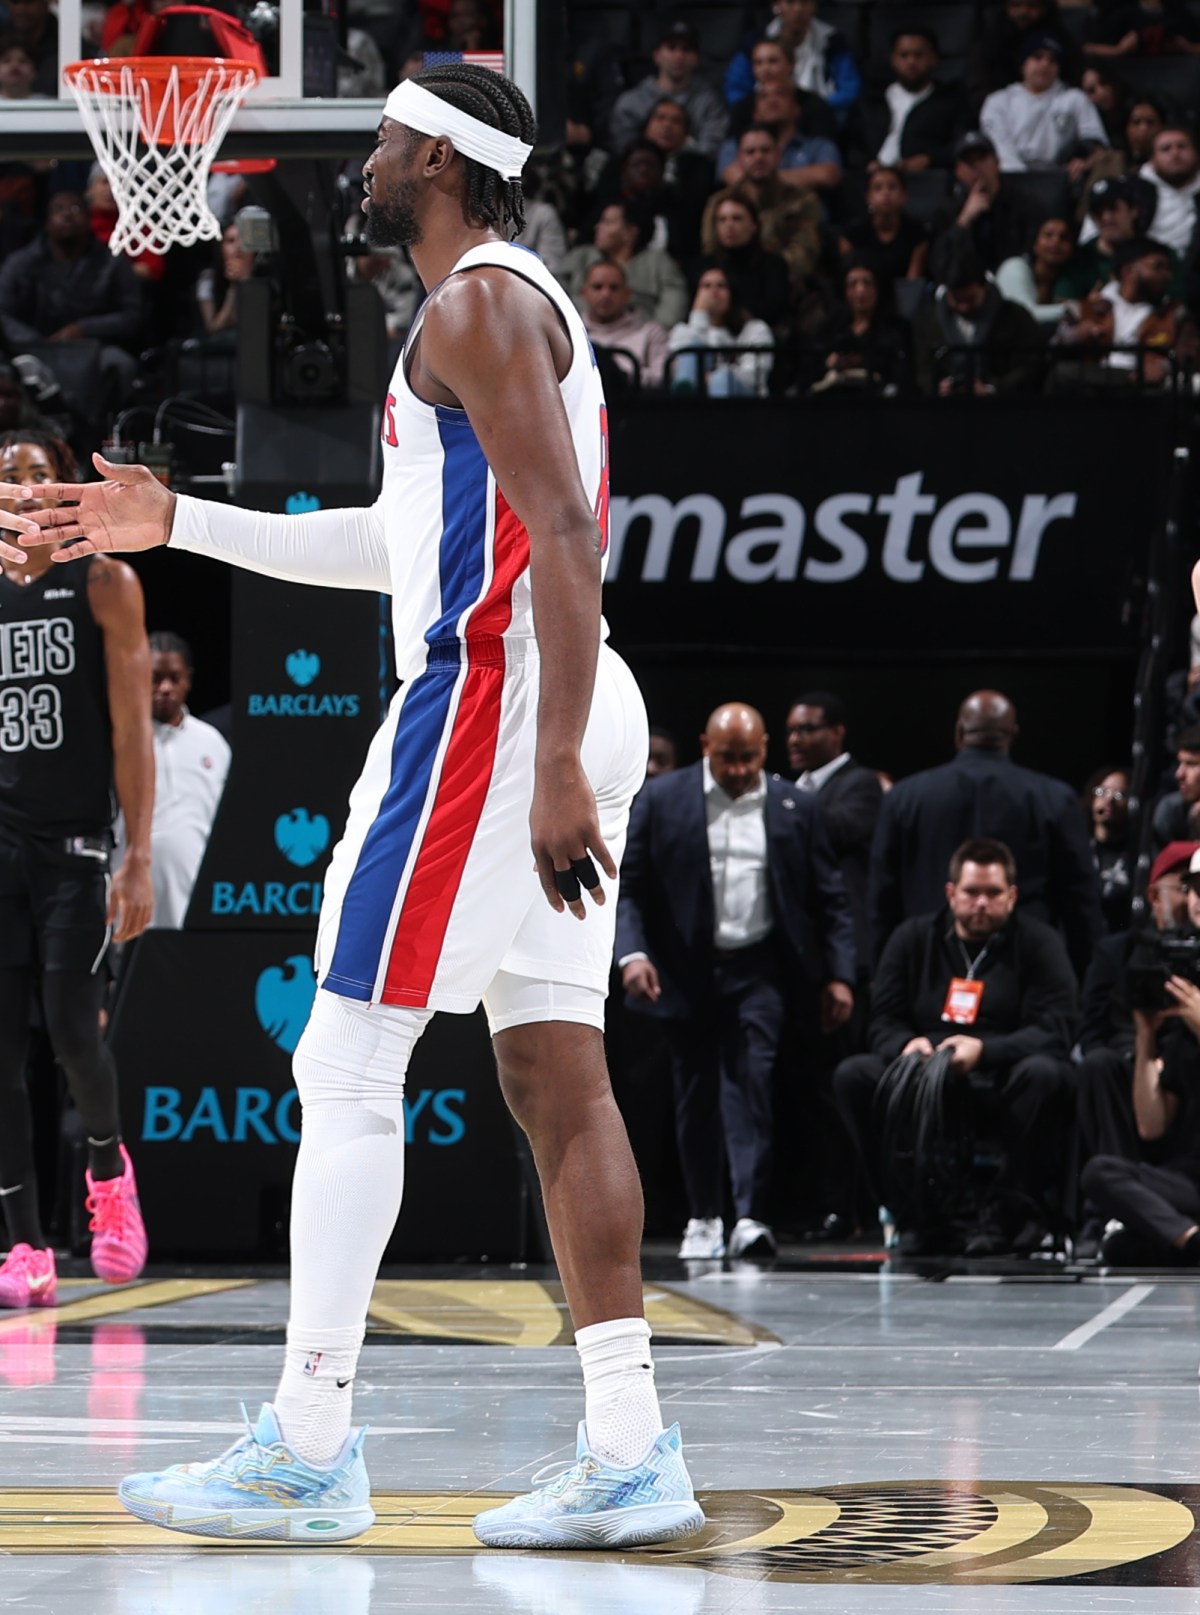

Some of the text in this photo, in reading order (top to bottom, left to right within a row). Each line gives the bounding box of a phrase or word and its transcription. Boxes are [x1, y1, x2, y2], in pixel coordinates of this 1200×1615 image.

[603, 471, 1077, 583] master
[247, 694, 360, 717] BARCLAYS
[211, 882, 322, 915] BARCL
[141, 1086, 467, 1145] BARCYS
